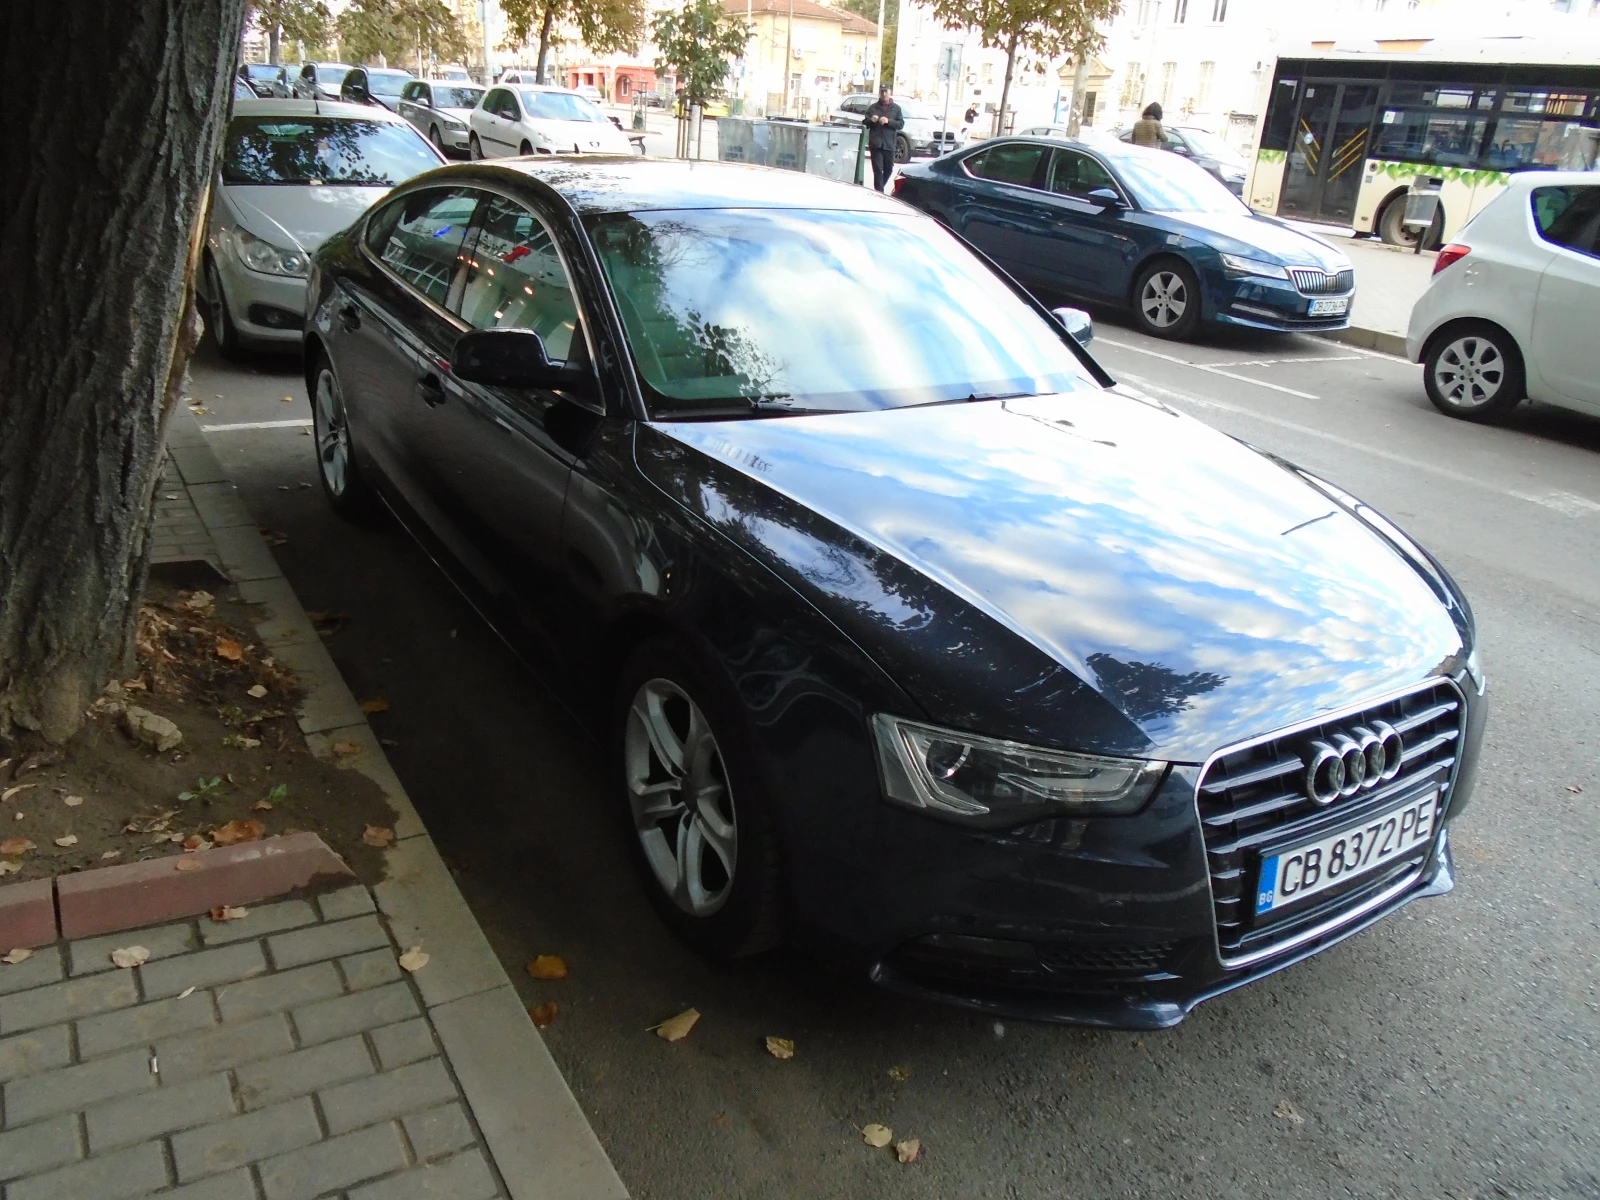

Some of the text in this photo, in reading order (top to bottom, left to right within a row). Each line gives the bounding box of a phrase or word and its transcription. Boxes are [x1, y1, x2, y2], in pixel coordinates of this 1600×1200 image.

[1314, 301, 1323, 311] CB
[1280, 798, 1433, 897] CB 8372 PE
[1259, 890, 1274, 907] BG
